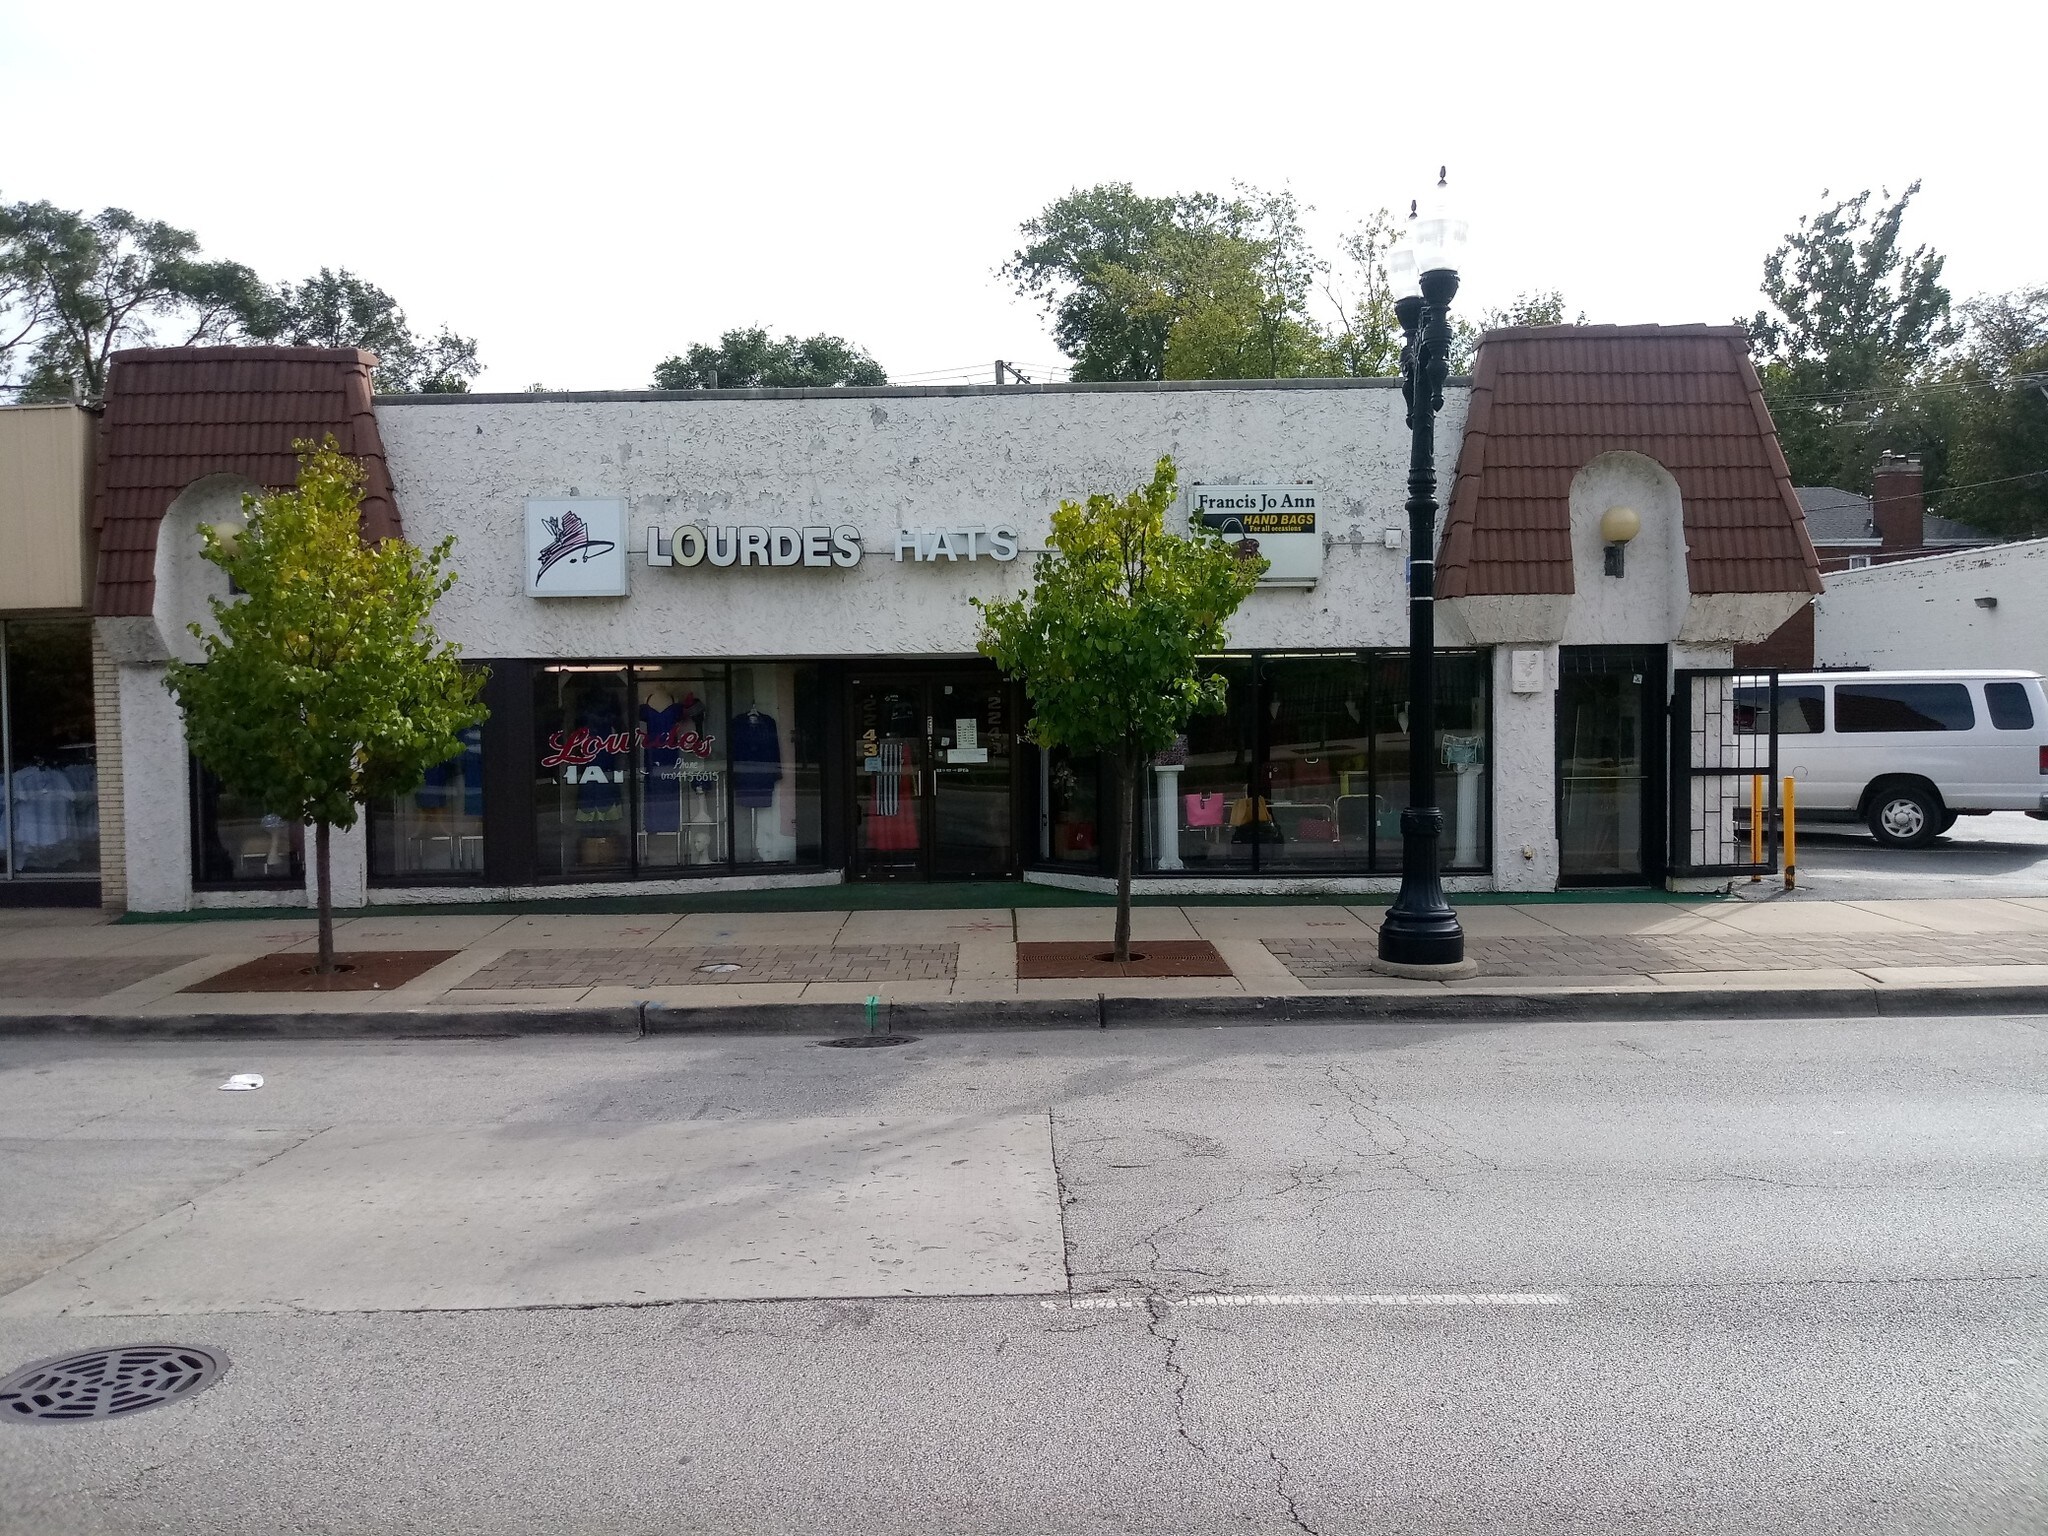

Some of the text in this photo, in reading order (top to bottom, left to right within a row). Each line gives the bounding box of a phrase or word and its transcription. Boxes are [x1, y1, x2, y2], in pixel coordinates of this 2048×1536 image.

[1198, 493, 1315, 512] Francis Jo Ann
[1243, 513, 1314, 525] HAND BAGS
[646, 524, 1019, 568] LOURDES HATS
[541, 724, 716, 768] Lourdes
[672, 757, 698, 770] Phone
